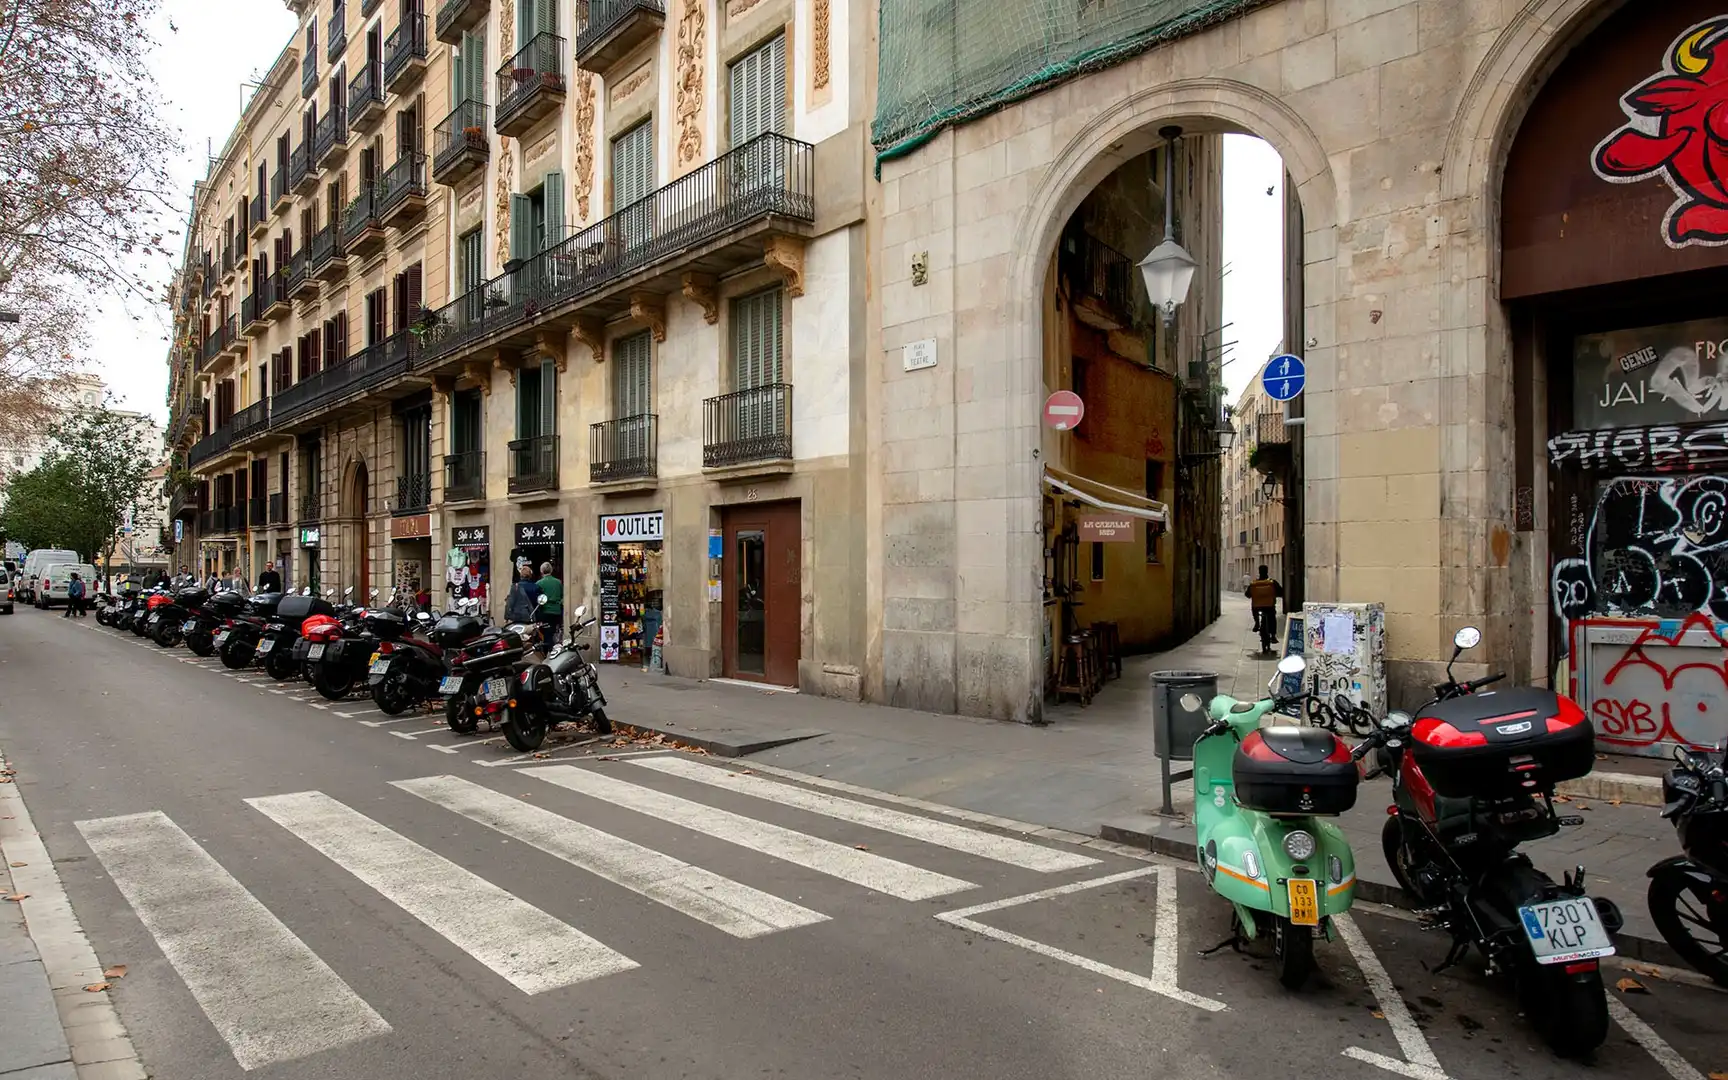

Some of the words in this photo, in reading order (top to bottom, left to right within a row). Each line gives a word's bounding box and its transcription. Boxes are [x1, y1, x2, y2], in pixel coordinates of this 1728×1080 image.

[1620, 346, 1657, 371] GENIE
[617, 516, 662, 536] OUTLET
[601, 565, 618, 573] DAD
[1294, 896, 1312, 906] 133
[1538, 902, 1594, 927] 7301
[1547, 925, 1586, 949] KLP
[1553, 950, 1601, 961] MundiMoto
